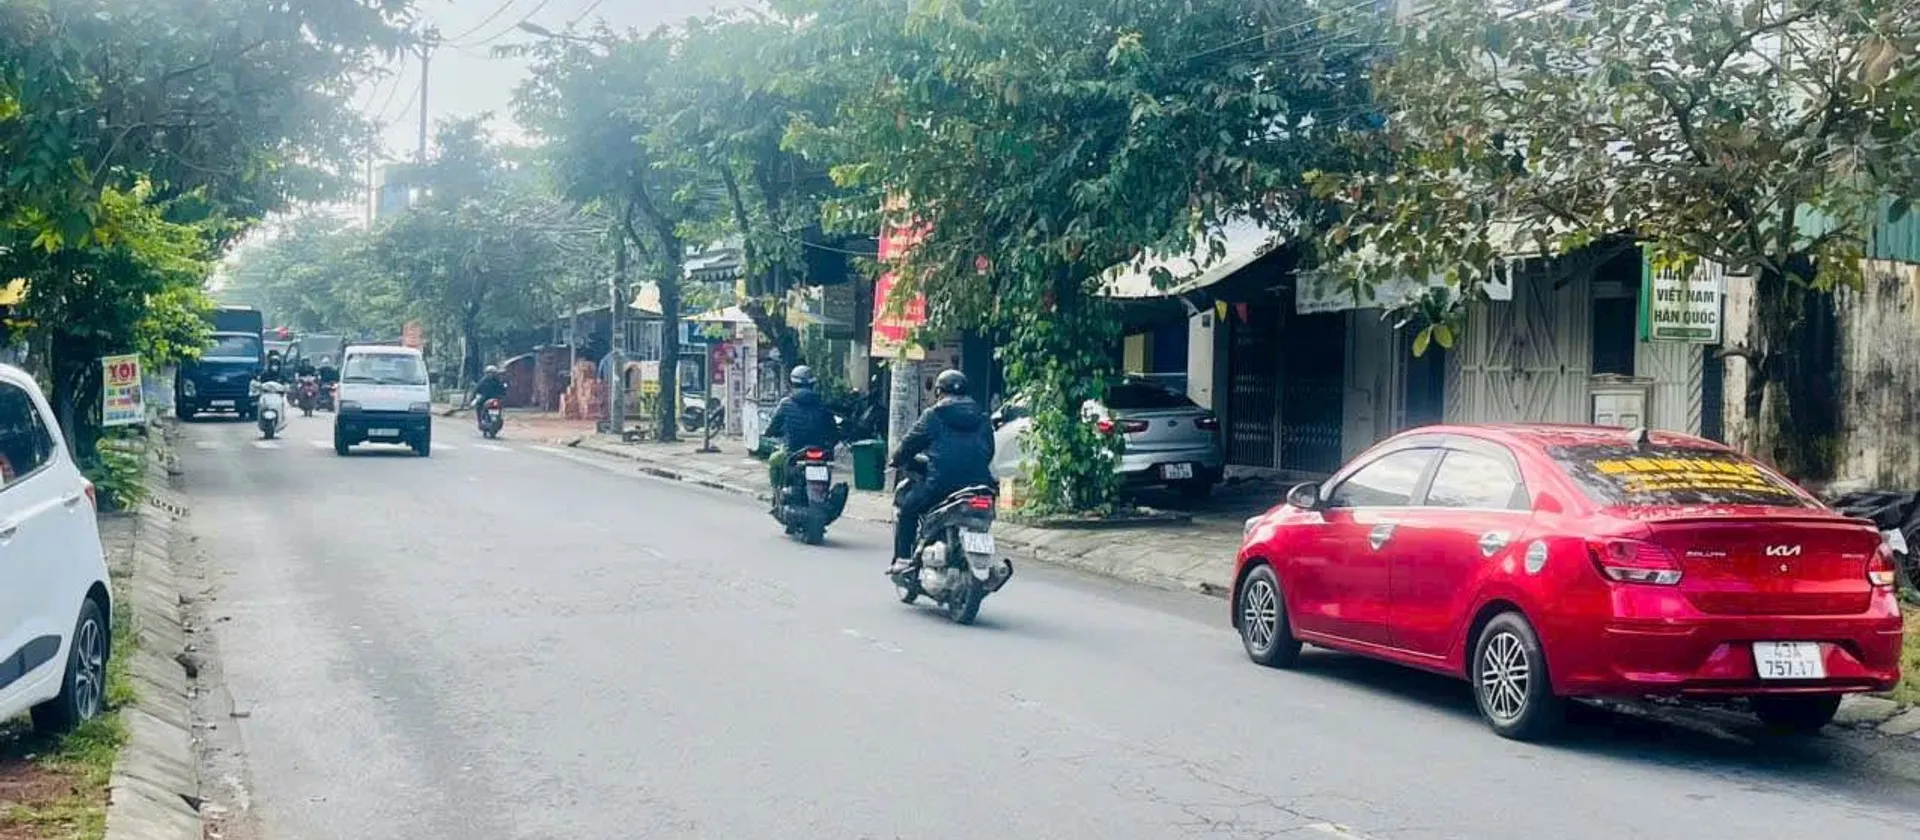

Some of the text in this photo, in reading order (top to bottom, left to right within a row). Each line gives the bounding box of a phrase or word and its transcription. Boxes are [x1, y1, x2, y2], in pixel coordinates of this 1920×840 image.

[1656, 287, 1715, 304] VIỆT NAM
[1654, 307, 1716, 325] HÀN QUỐC
[1765, 544, 1801, 556] KIA
